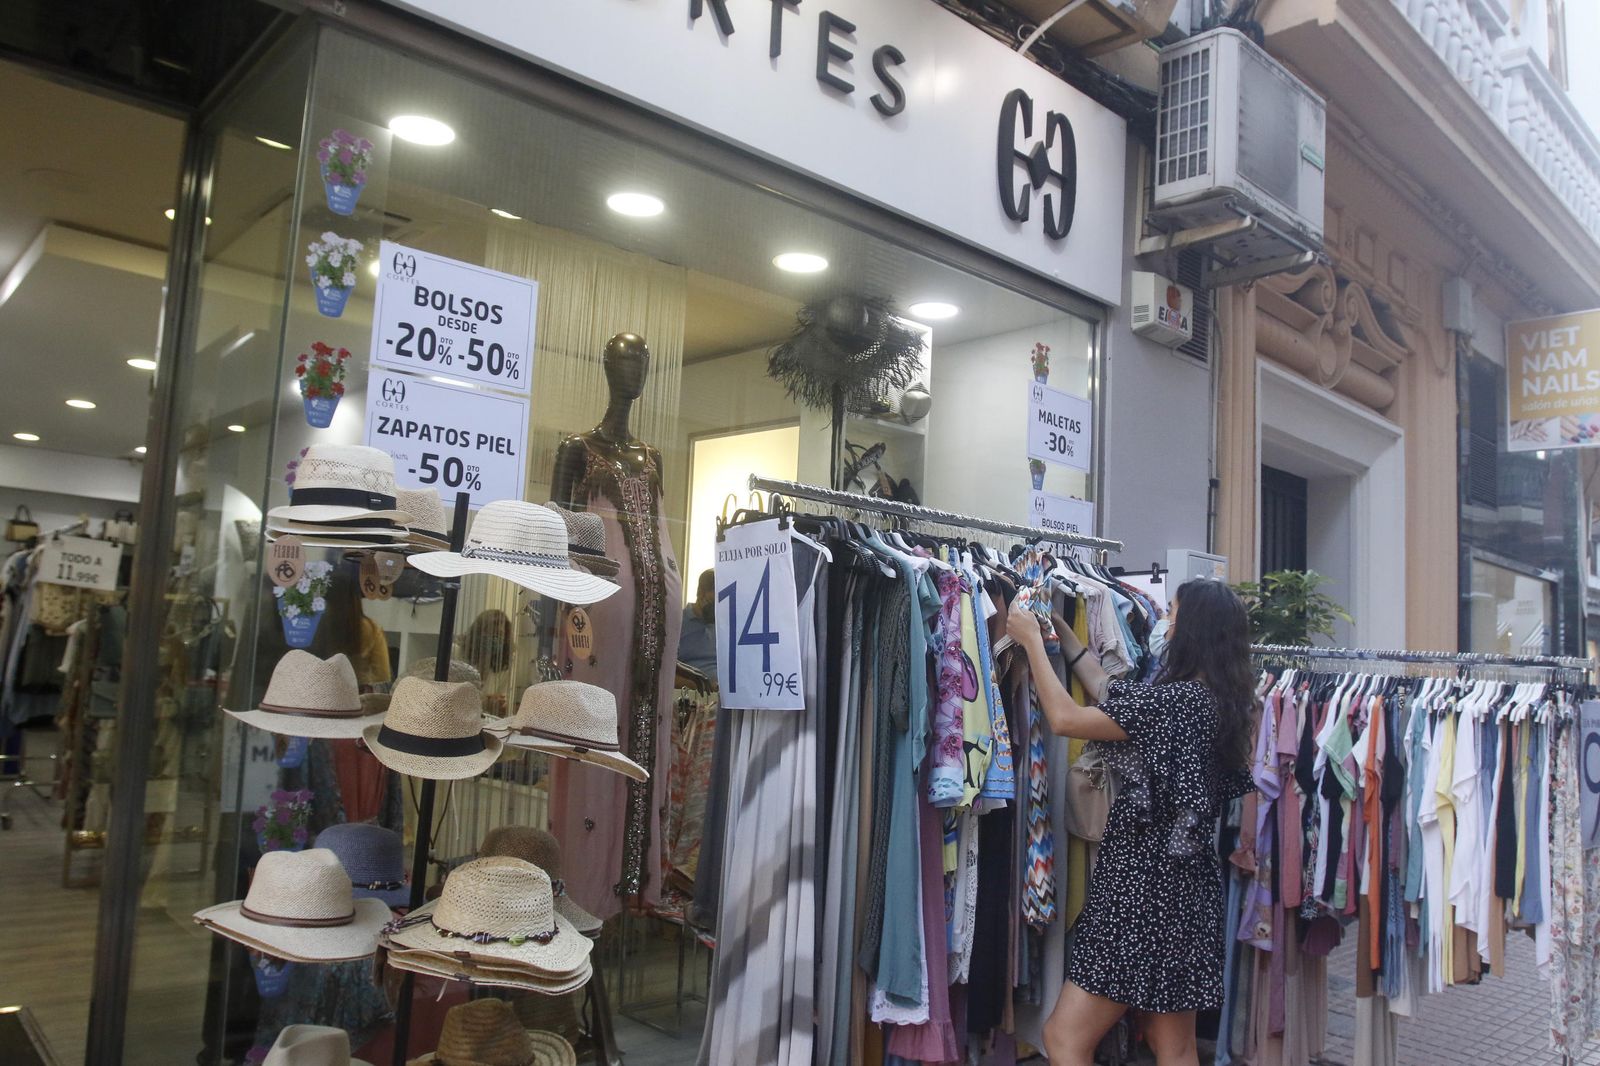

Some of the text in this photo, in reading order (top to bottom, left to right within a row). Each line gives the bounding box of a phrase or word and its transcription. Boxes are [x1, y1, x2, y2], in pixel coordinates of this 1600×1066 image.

[414, 285, 503, 325] BOLSOS
[438, 315, 477, 334] DESDE
[440, 337, 453, 345] DTO
[507, 352, 520, 360] DTO
[1520, 325, 1581, 351] VIET
[1522, 348, 1588, 374] NAM
[1522, 370, 1600, 397] NAILS
[376, 400, 410, 412] CORTES
[1553, 398, 1570, 409] de
[1038, 408, 1081, 434] MALETAS
[377, 416, 515, 456] ZAPATOS PIEL
[1042, 518, 1079, 534] BOLSOS PIEL
[61, 552, 103, 566] TODO A
[718, 542, 787, 562] ELIJA POR SOLO
